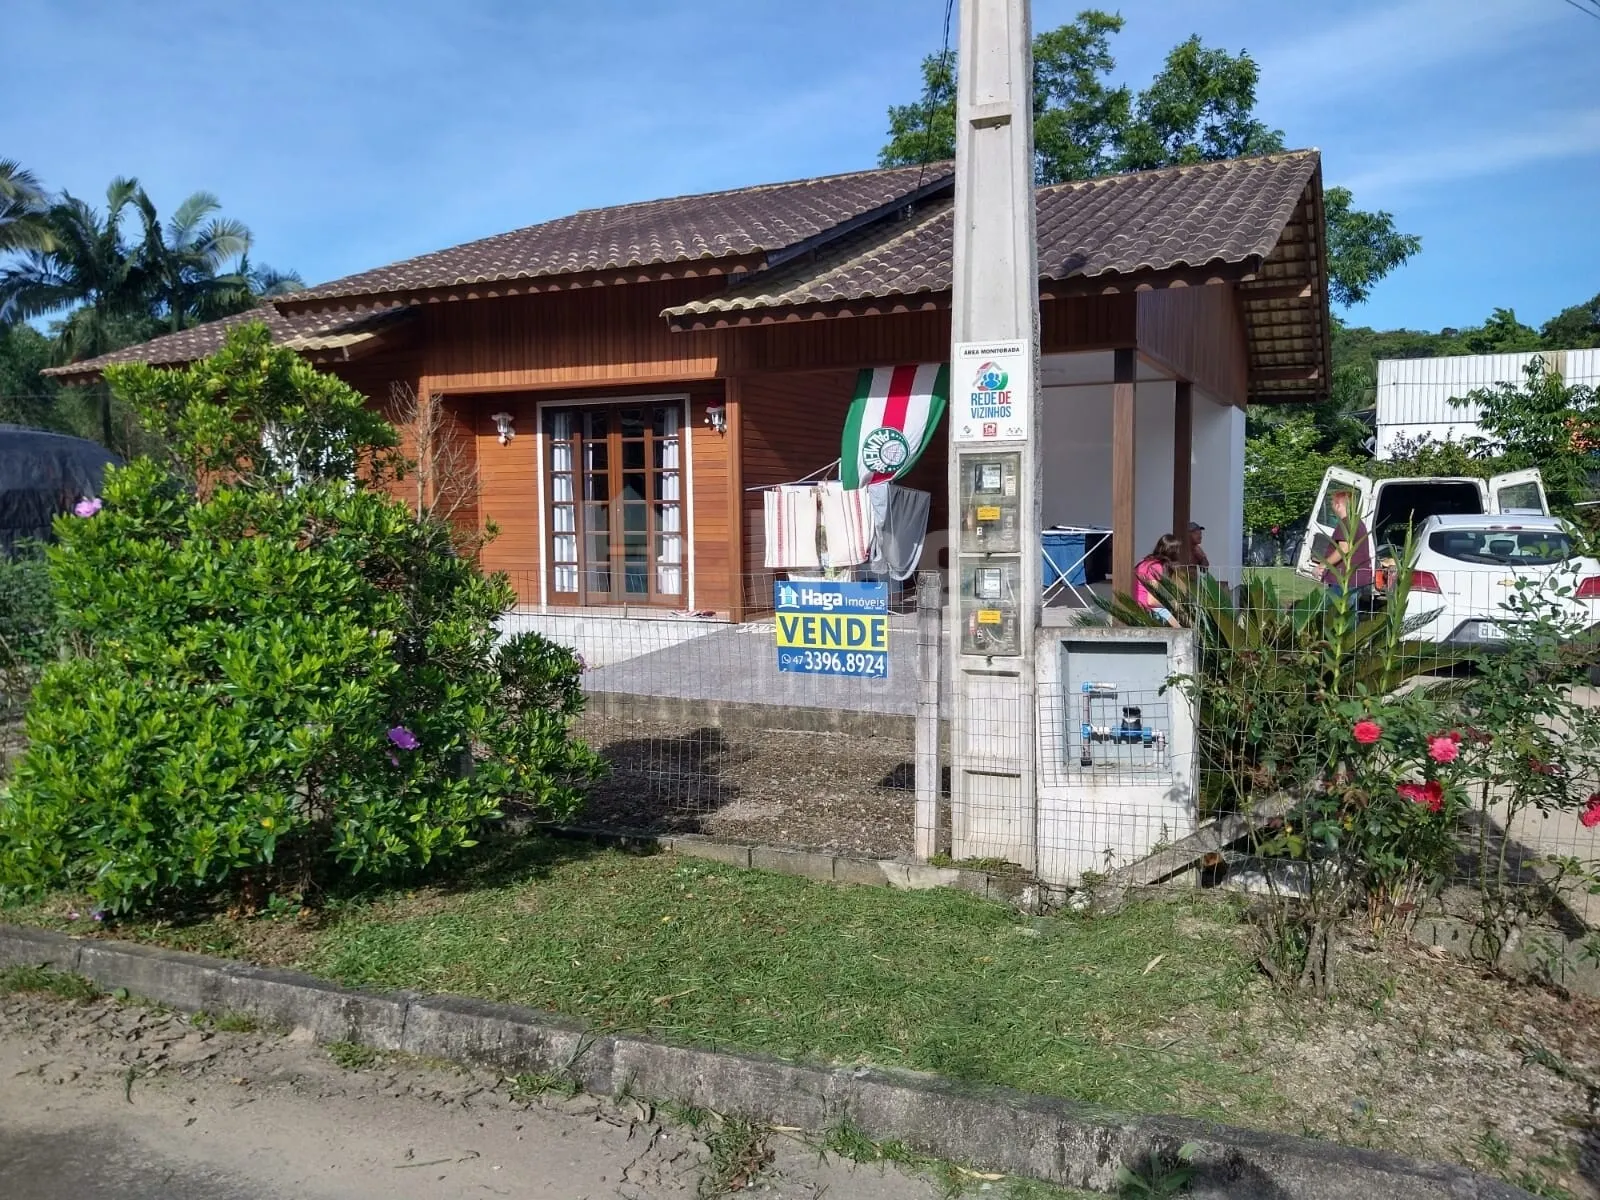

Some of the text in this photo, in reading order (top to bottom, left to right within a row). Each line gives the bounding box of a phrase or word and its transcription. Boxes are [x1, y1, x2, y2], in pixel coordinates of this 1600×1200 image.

[981, 347, 1020, 355] MONITORADA
[971, 391, 1012, 406] REDE DE
[971, 405, 1012, 419] VIZINHOS
[801, 589, 885, 611] Haga Imóveis
[778, 616, 885, 648] VENDE
[792, 651, 885, 674] 47 3396.8924
